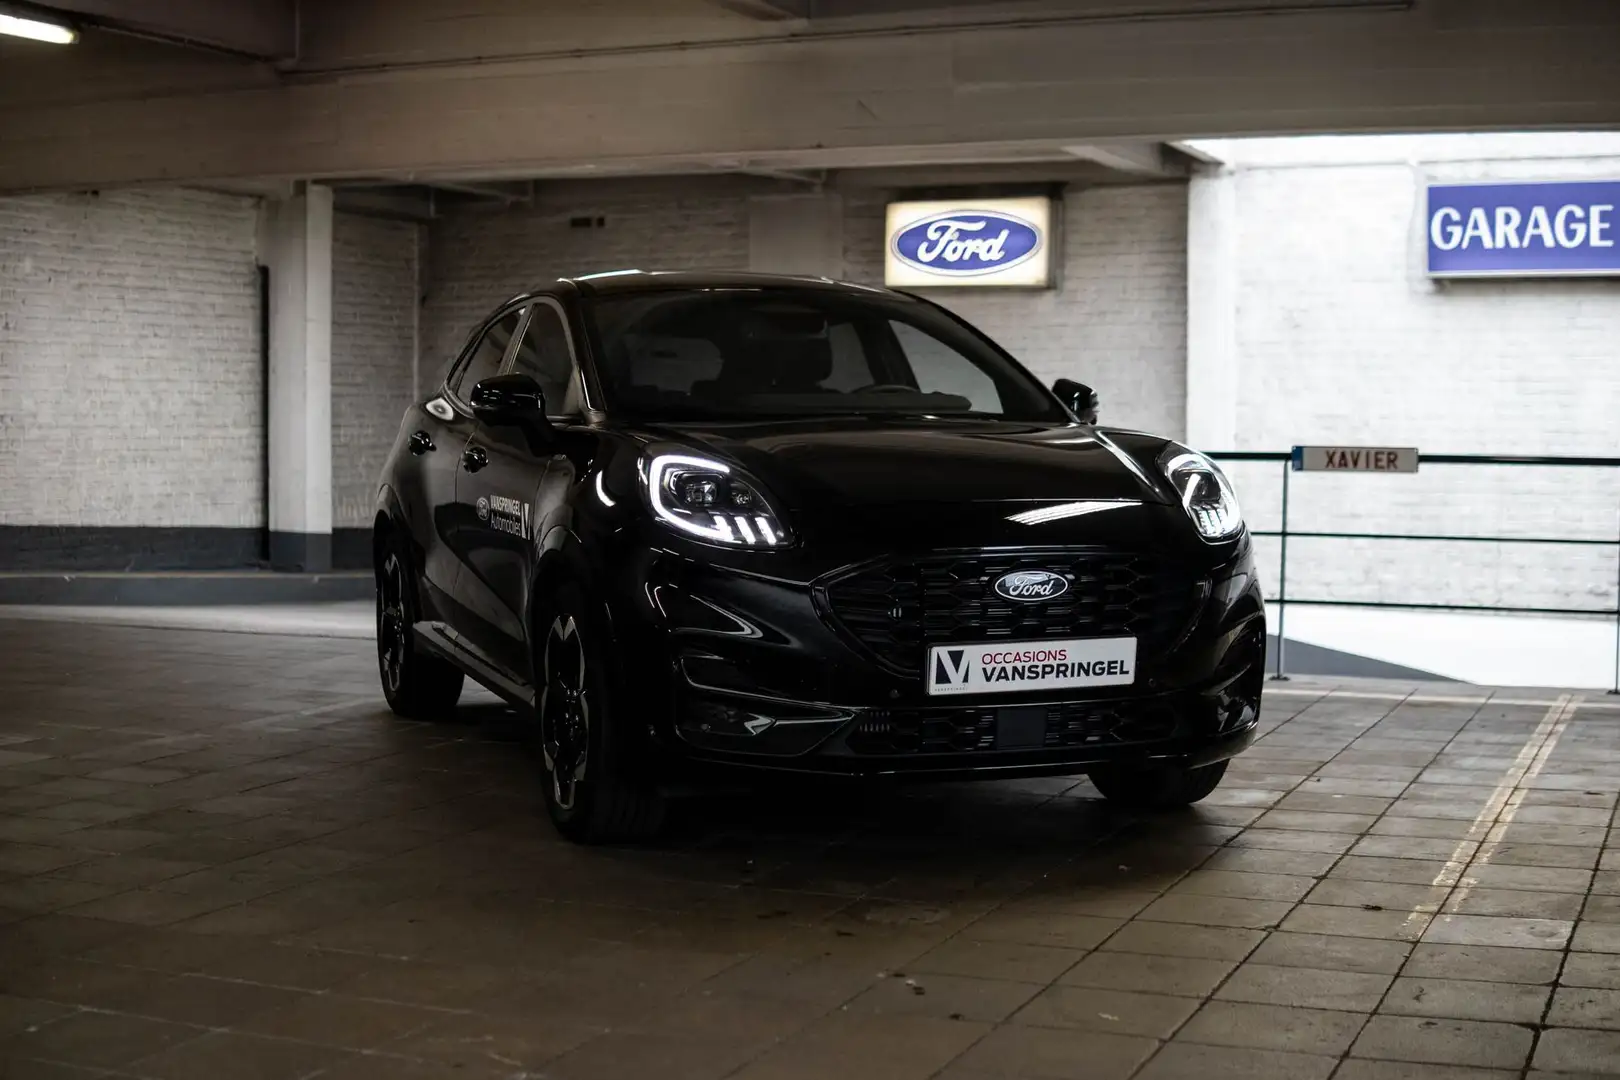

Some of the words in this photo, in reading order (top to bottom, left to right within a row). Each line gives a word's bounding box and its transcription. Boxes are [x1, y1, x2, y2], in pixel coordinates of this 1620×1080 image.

[1430, 203, 1614, 251] GARAGE
[917, 219, 1010, 263] Ford
[1325, 449, 1398, 470] XAVIER
[1009, 576, 1053, 596] Ford
[981, 649, 1067, 665] OCCASIONS
[981, 660, 1129, 683] VANSPRINGEL
